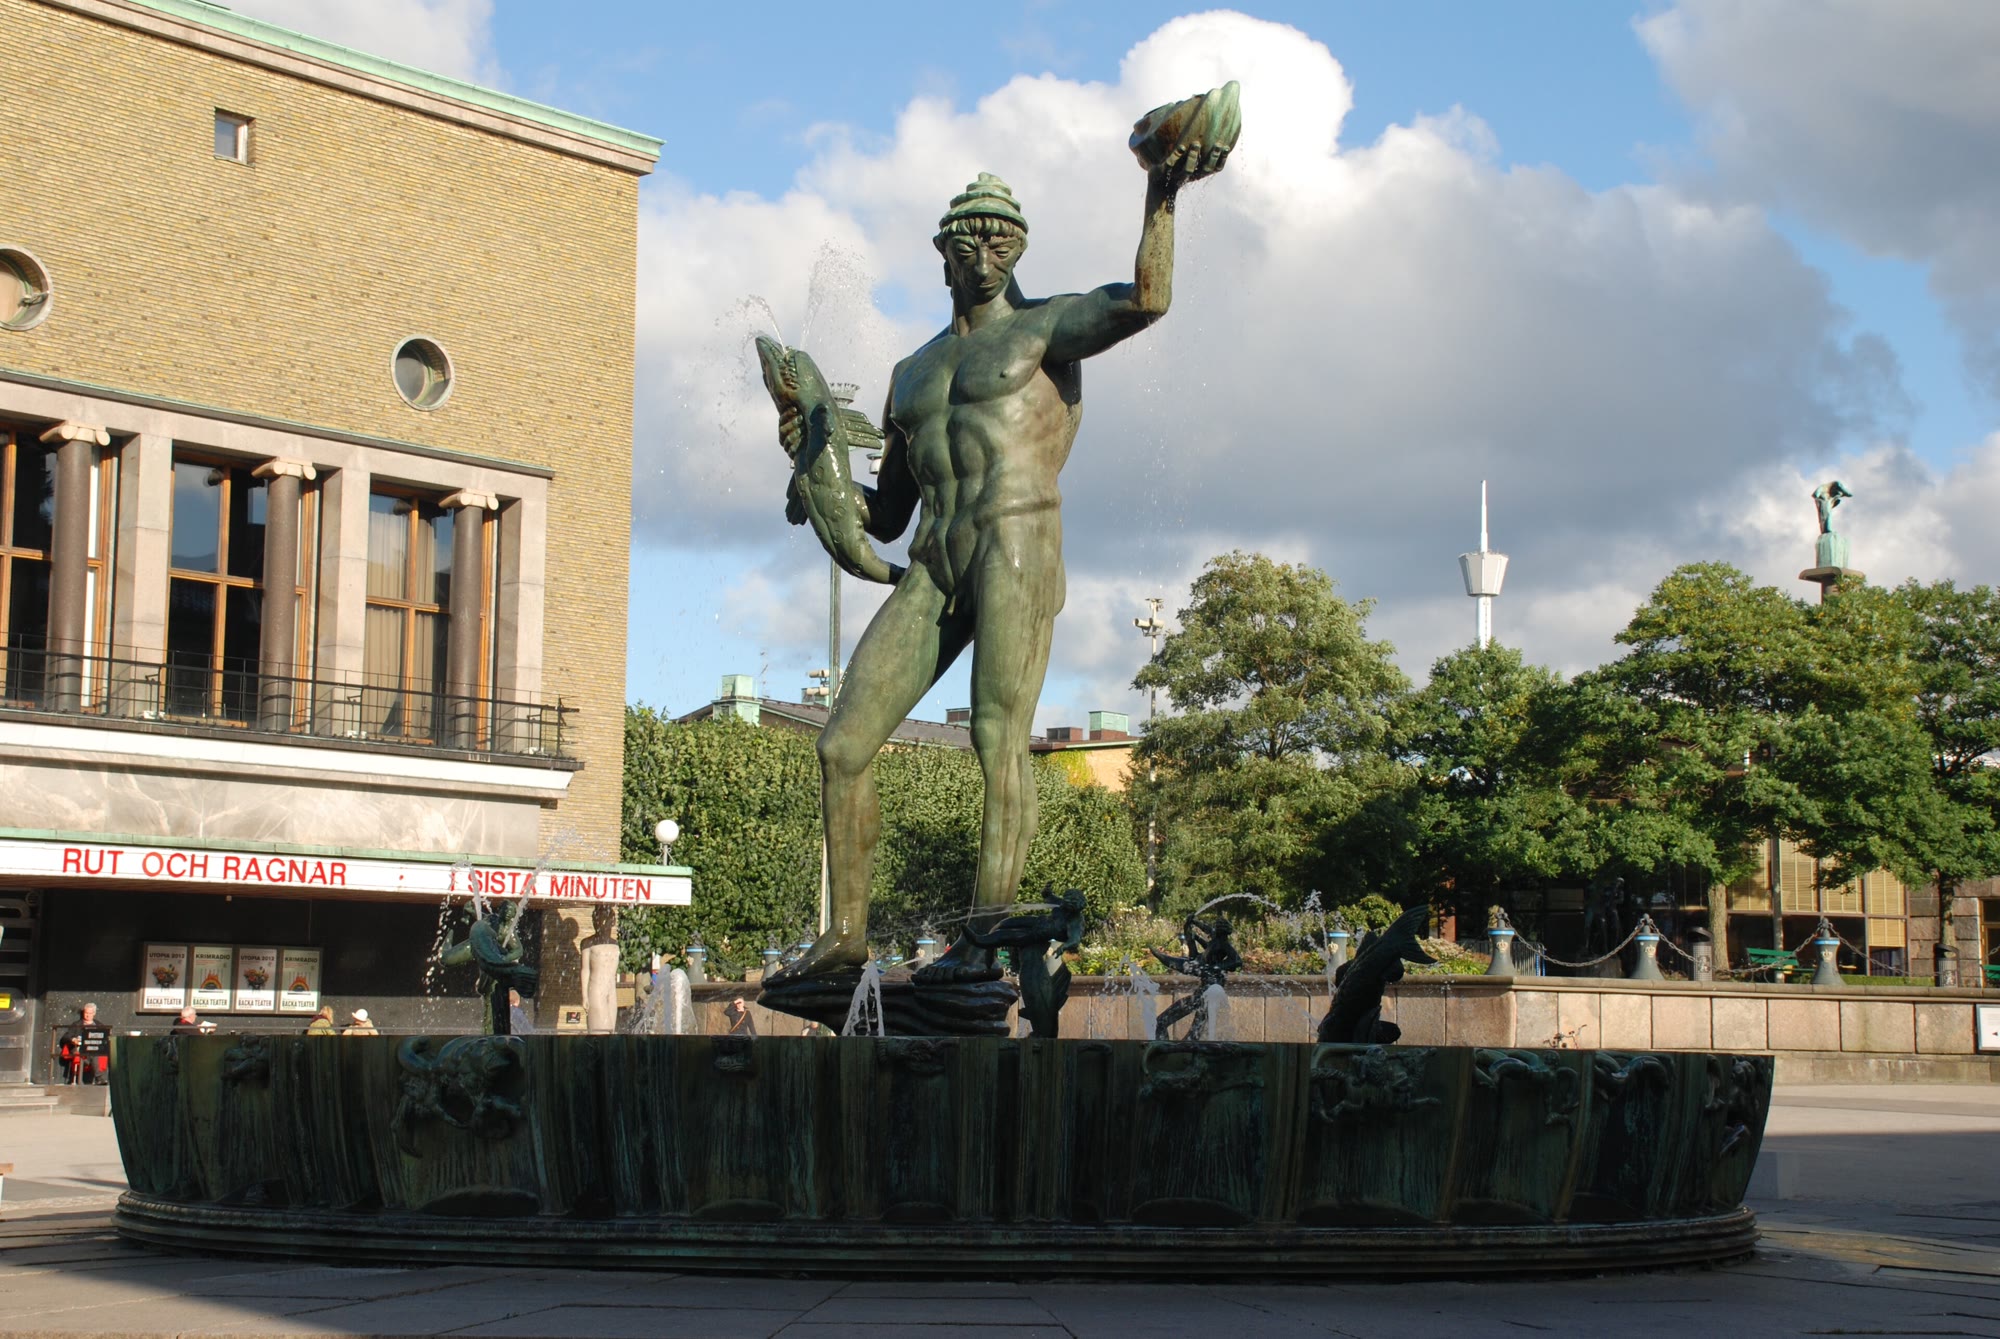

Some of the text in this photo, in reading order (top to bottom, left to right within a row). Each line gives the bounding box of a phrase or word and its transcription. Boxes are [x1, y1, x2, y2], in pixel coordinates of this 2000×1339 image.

[62, 848, 347, 886] RUT OCH RAGNAR
[468, 869, 537, 896] SISTA
[550, 874, 652, 900] MINUTEN
[146, 997, 163, 1005] BACKA
[164, 998, 182, 1006] TEATER
[192, 998, 228, 1006] BACKA TEATER
[238, 999, 254, 1007] BACKA
[255, 999, 272, 1007] TEATER
[282, 999, 297, 1007] BACKA
[298, 1000, 315, 1008] TEATER
